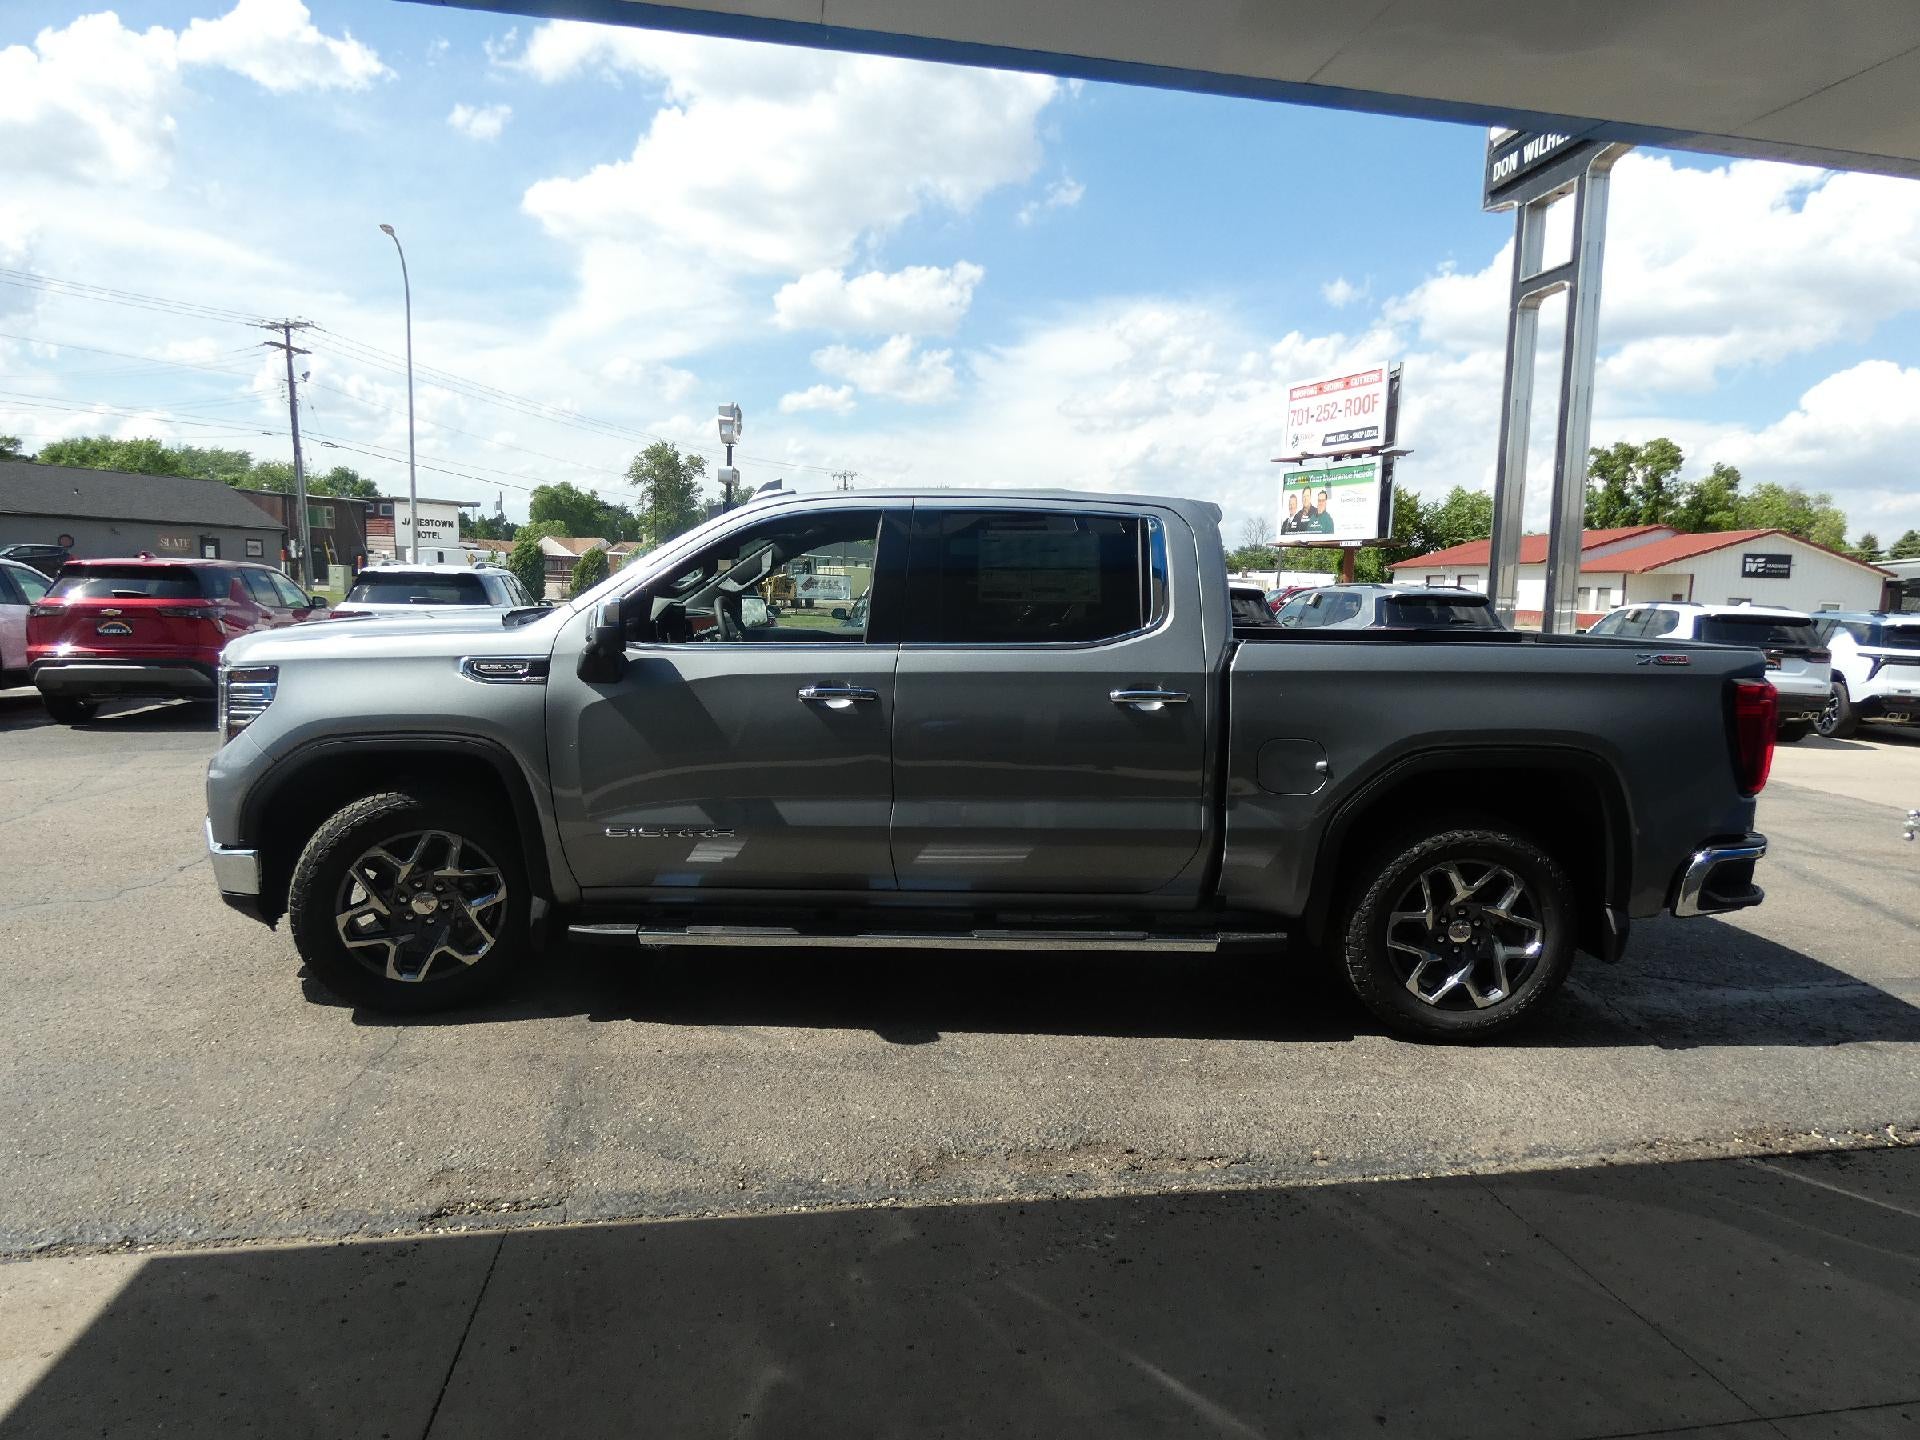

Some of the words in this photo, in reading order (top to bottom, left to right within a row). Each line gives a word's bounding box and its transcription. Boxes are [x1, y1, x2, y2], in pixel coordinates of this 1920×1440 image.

[1493, 150, 1519, 182] DON
[1523, 133, 1571, 164] WILH
[1290, 393, 1380, 427] 701-252-ROOF
[160, 537, 190, 548] SLATE
